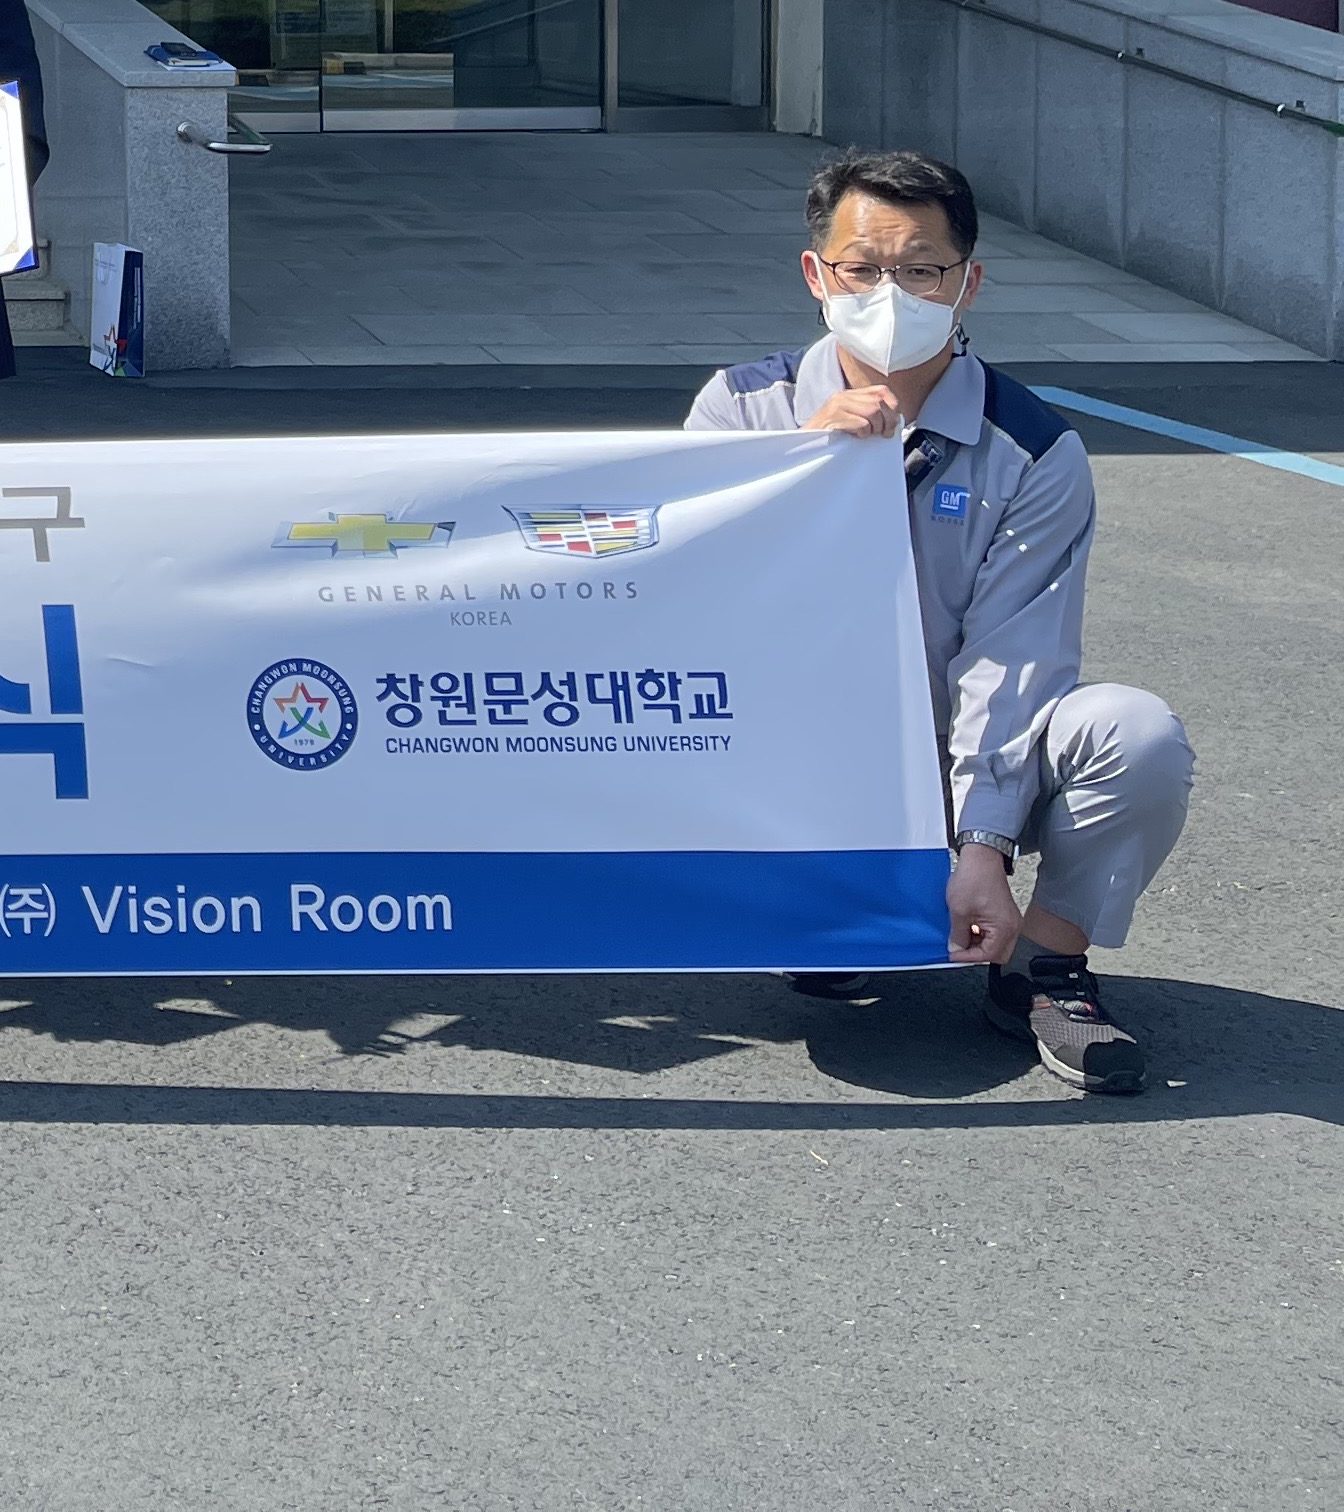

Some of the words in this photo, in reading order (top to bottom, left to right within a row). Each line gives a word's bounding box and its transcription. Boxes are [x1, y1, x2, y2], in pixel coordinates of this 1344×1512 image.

[941, 491, 960, 506] GM
[319, 584, 476, 603] GENERAL
[500, 582, 638, 600] MOTORS
[450, 610, 512, 626] KOREA
[375, 669, 734, 728] 창원문성대학교
[386, 737, 499, 754] CHANGWON
[506, 736, 617, 753] MOONSUNG
[623, 735, 731, 751] UNIVERSITY
[81, 884, 262, 934] Vision
[290, 884, 453, 931] Room
